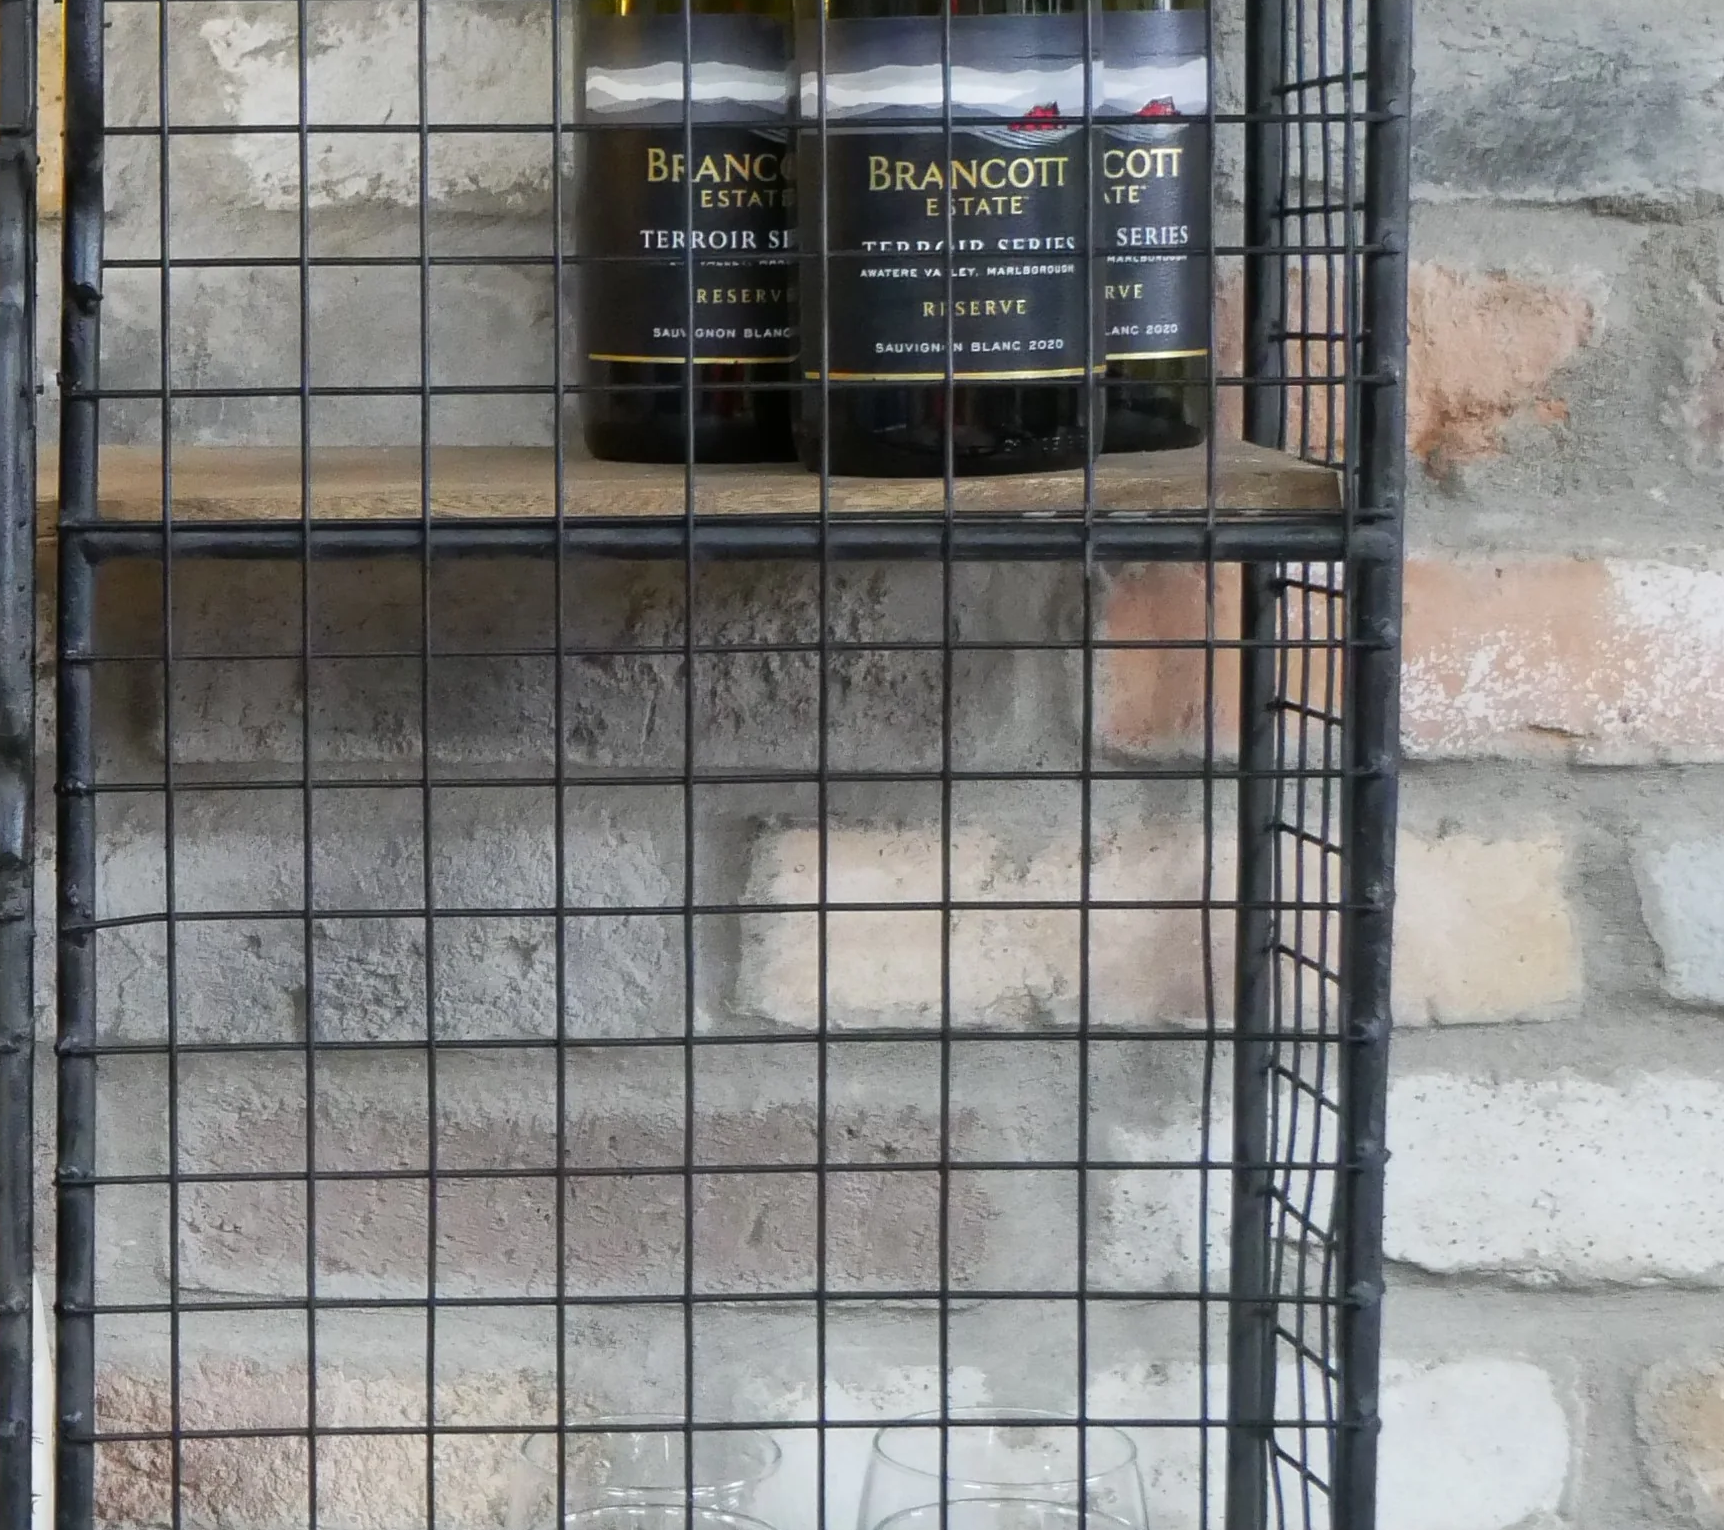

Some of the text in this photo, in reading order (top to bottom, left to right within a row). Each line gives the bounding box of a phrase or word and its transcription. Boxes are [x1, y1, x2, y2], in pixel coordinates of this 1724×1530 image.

[1104, 148, 1183, 178] COTT
[868, 156, 1068, 191] BRANCOTT
[640, 230, 756, 248] TERROIR
[1117, 225, 1189, 247] SERIES
[860, 269, 917, 278] AWATERE
[1146, 324, 1178, 335] 2020
[876, 339, 1064, 353] SAUVIGNN BLANC 2020
